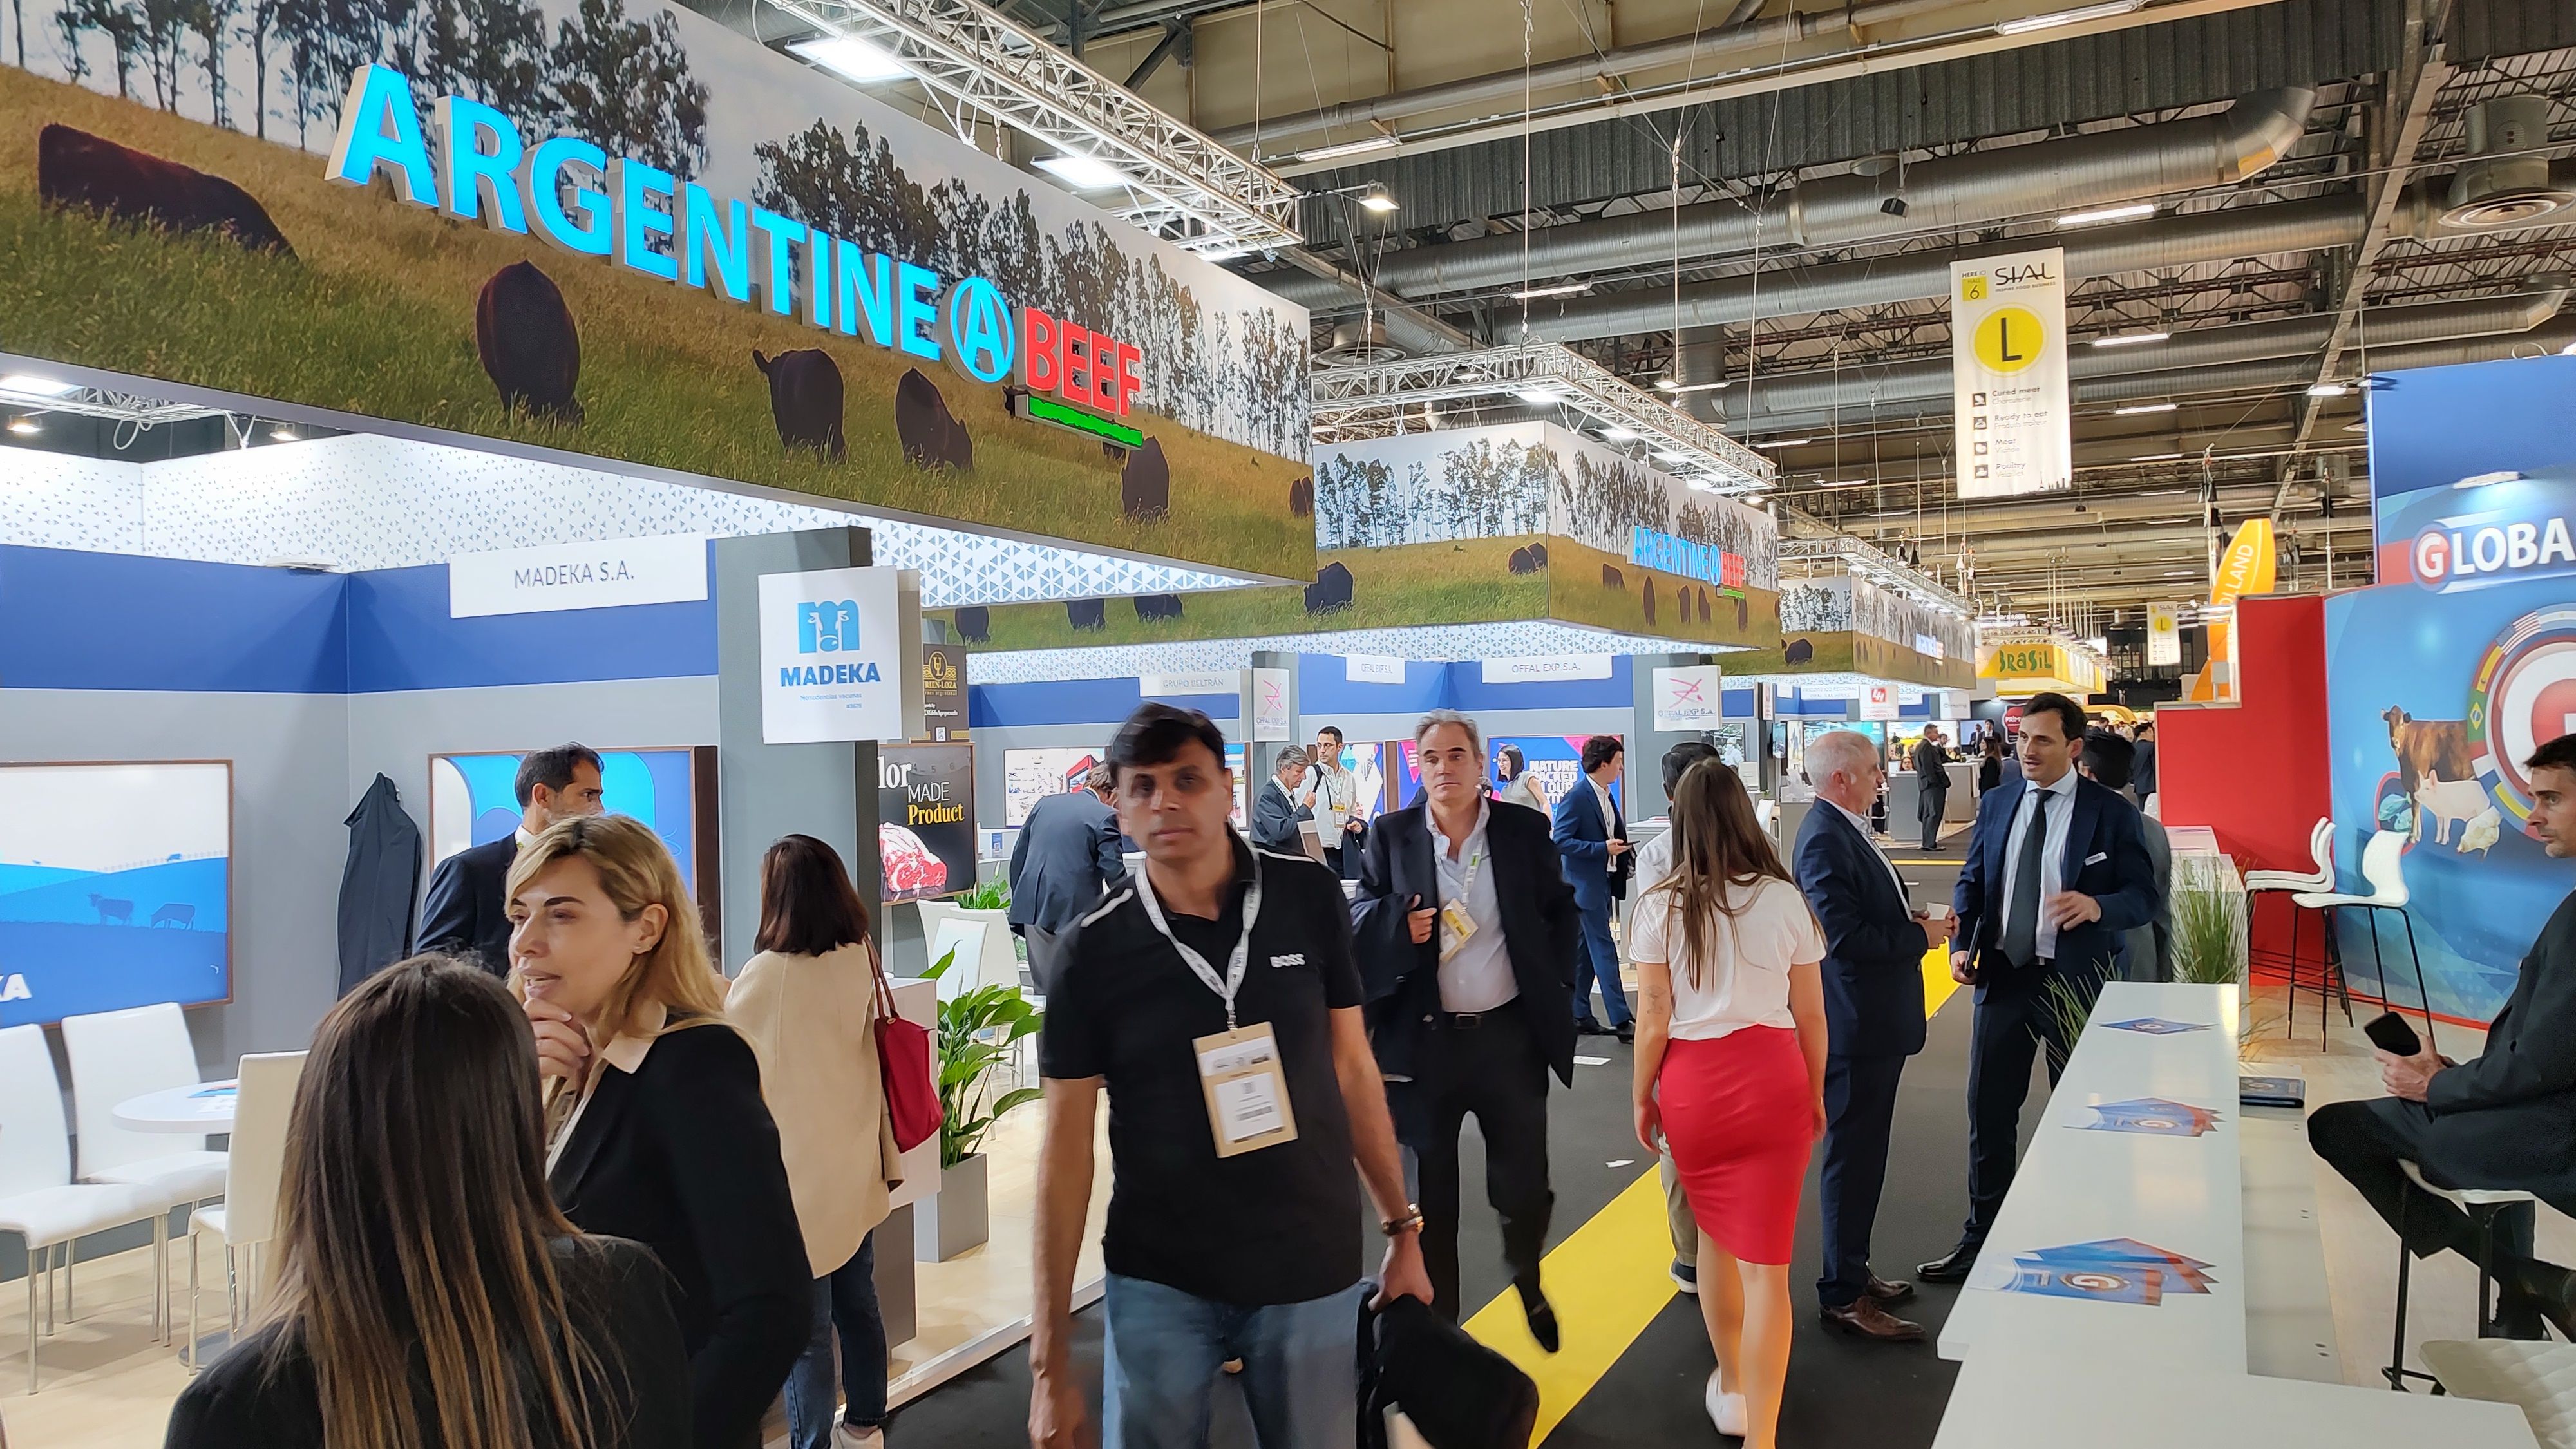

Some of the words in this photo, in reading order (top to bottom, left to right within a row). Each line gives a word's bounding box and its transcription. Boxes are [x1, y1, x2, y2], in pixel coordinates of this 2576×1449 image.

[326, 62, 942, 362] ARGENTINE
[1023, 305, 1141, 417] BEEF
[1994, 262, 2056, 286] SIAL
[1969, 285, 1980, 299] 6
[2000, 317, 2022, 362] L
[1992, 388, 2016, 397] Cured
[1994, 412, 2021, 421] Ready
[1996, 461, 2026, 470] Poultry
[1632, 525, 1709, 581] ARGENTINE
[1720, 551, 1745, 589] BEEF
[515, 563, 594, 589] MADEKA
[600, 560, 634, 582] S.A.
[2160, 618, 2167, 632] L
[780, 662, 882, 687] MADEKA
[1511, 664, 1540, 674] OFFAL
[1543, 663, 1560, 672] EXP
[1563, 662, 1582, 671] S.A.
[1162, 679, 1190, 688] GRUPO
[1658, 709, 1683, 717] OFFAL
[877, 755, 913, 789] lor
[1529, 759, 1579, 772] NATURE
[907, 782, 951, 803] MADE
[907, 802, 965, 826] Product
